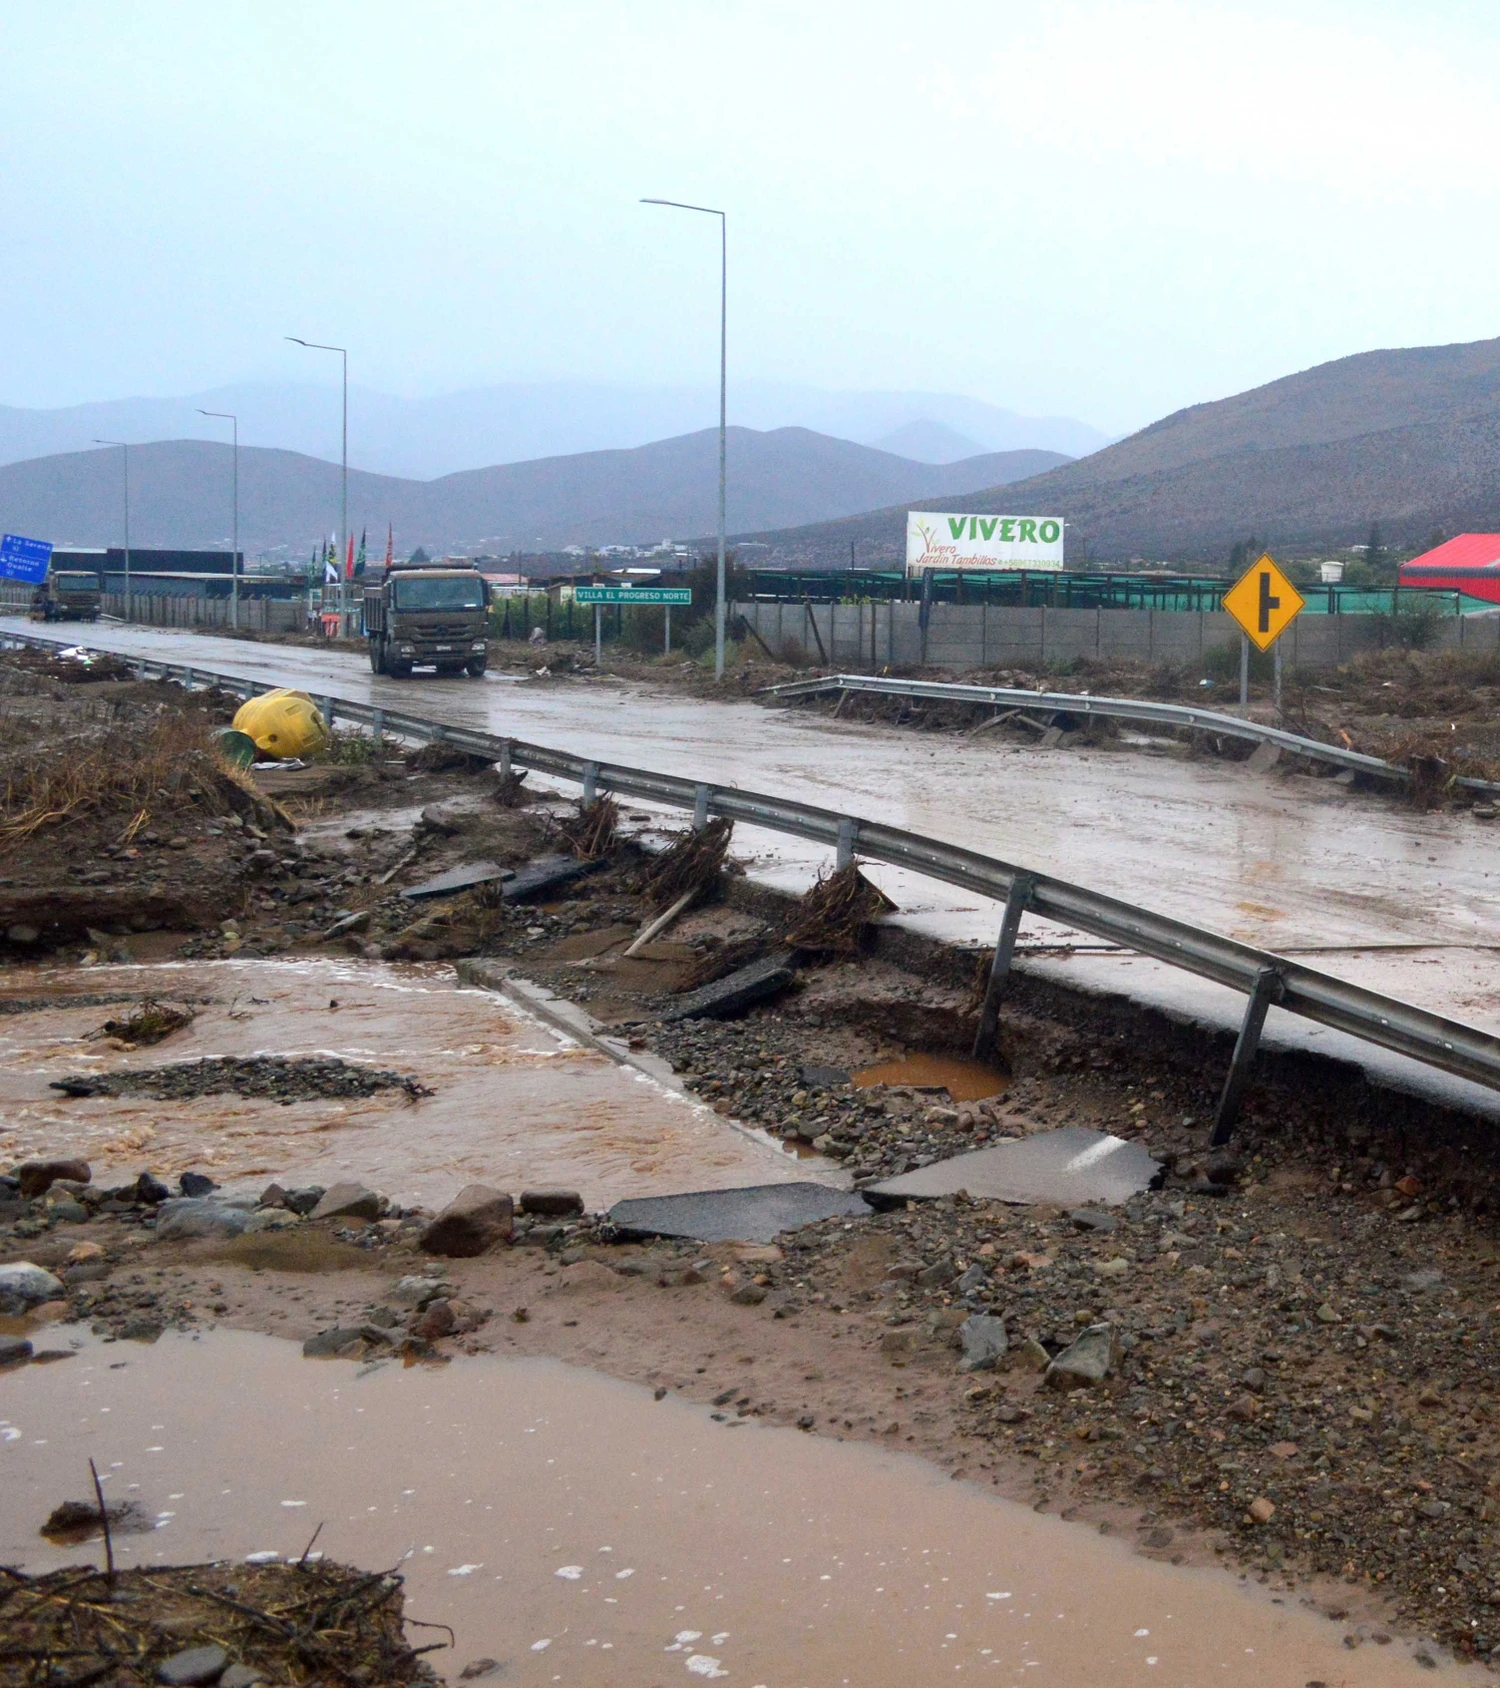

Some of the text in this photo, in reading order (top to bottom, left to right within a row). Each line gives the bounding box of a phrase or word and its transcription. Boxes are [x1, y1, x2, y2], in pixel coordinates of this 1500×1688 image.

[948, 516, 1060, 543] VIVERO
[13, 538, 50, 550] La Serena
[952, 553, 998, 566] Tambillos
[7, 562, 32, 572] Ovalle
